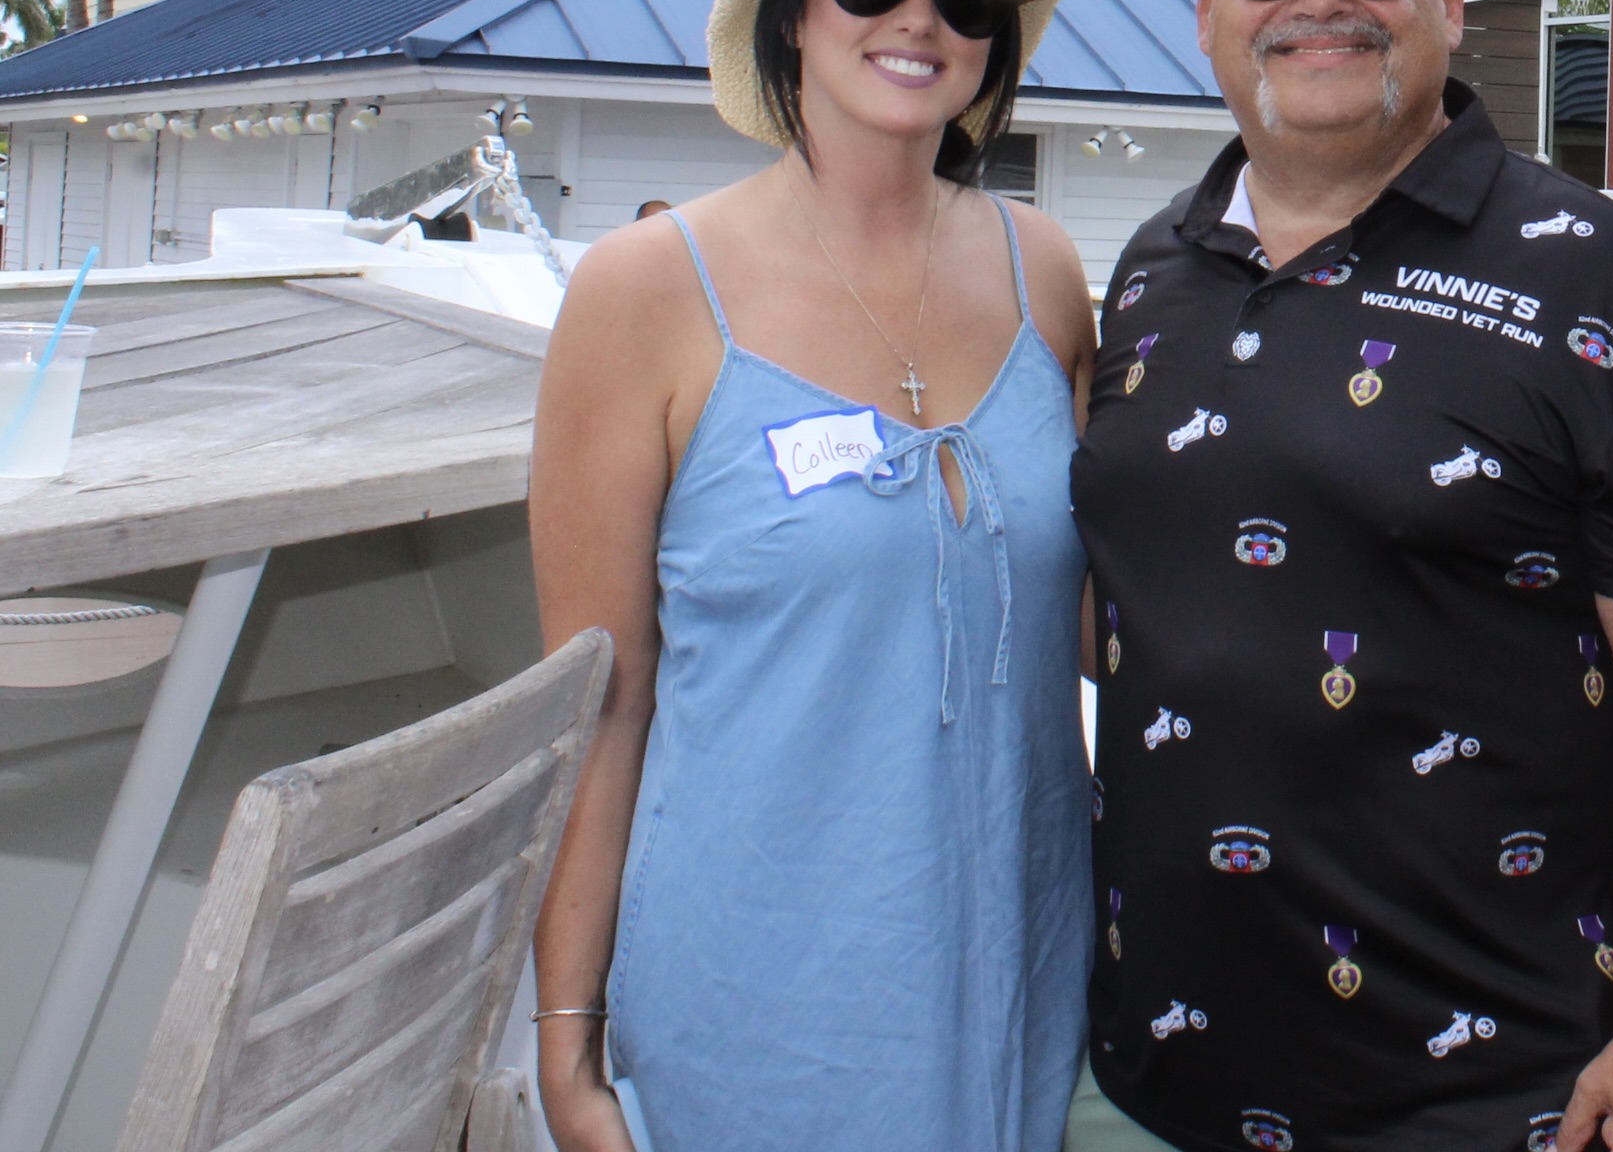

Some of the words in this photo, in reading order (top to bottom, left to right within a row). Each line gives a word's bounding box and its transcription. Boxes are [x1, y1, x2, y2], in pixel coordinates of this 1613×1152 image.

[1361, 291, 1458, 320] WOUNDED
[1462, 310, 1500, 332] VET
[1501, 322, 1543, 349] RUN
[1396, 266, 1541, 321] VINNIE'S
[792, 431, 874, 475] Colleen
